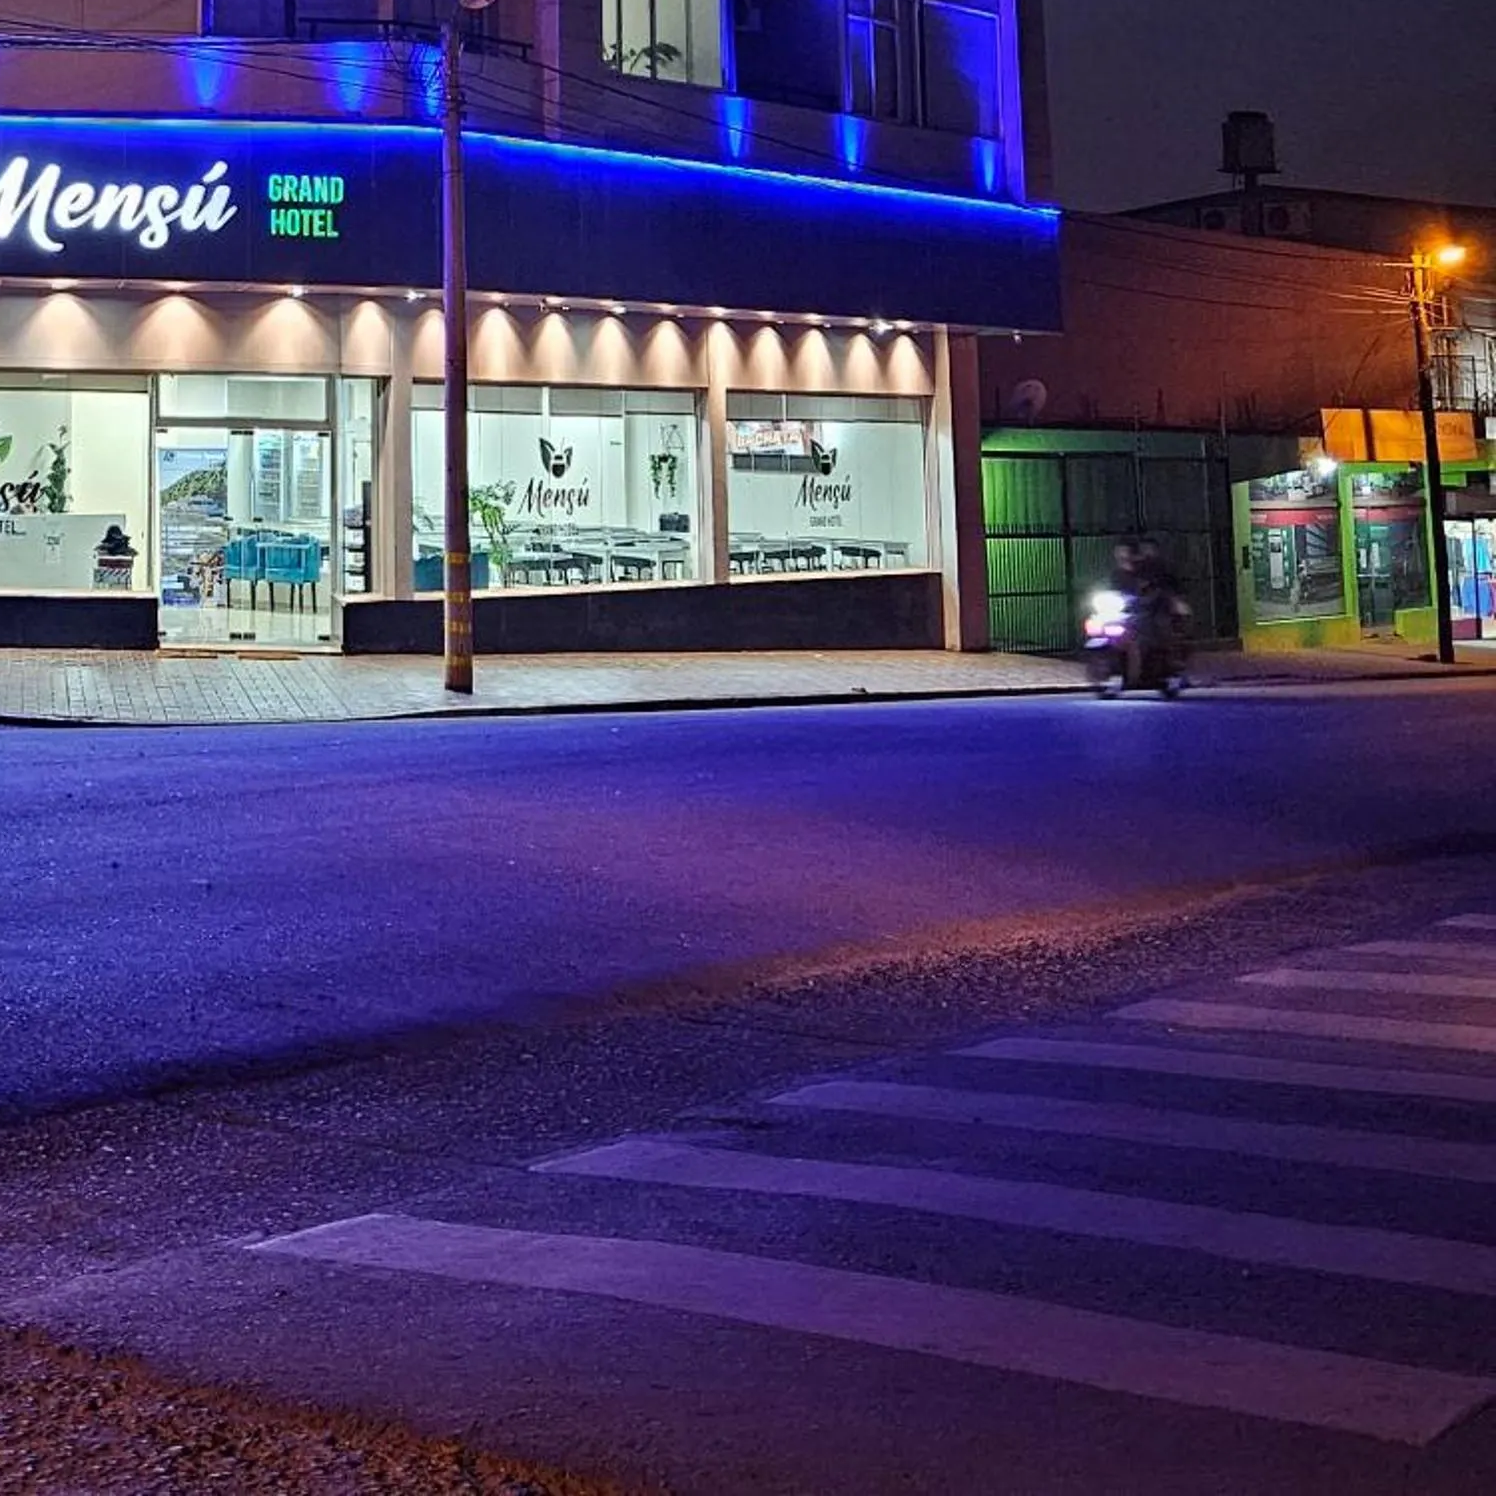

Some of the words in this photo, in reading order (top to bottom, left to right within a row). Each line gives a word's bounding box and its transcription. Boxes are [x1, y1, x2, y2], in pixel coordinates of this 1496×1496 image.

[267, 173, 345, 205] GRAND
[270, 208, 339, 239] HOTEL
[517, 476, 590, 518] Mensú
[794, 474, 851, 511] Mensú
